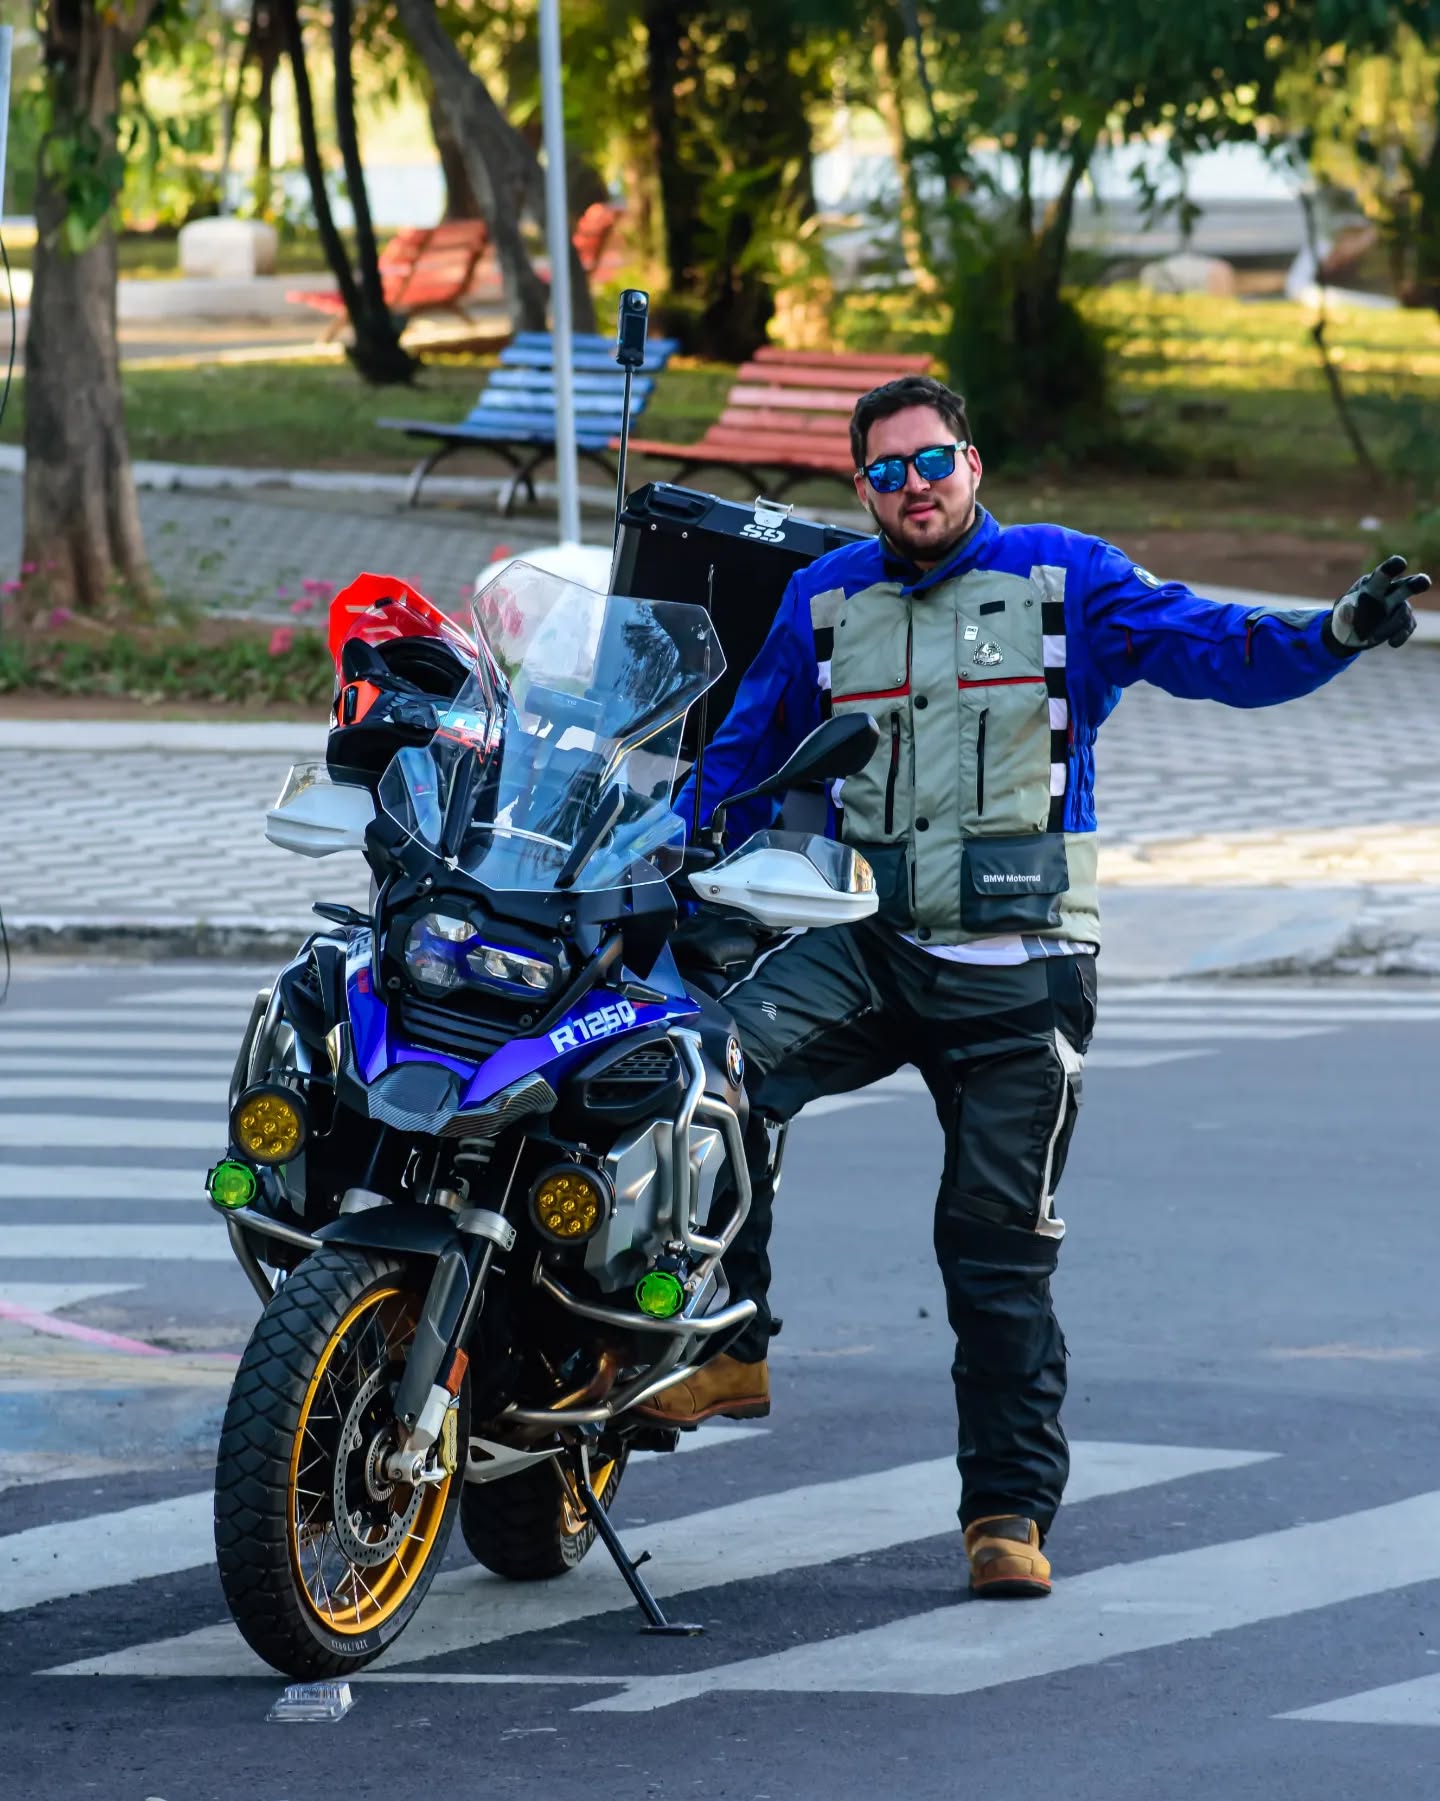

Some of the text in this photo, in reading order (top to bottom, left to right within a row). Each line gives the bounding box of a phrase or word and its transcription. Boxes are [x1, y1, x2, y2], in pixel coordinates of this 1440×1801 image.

[739, 523, 786, 543] GS
[983, 874, 1041, 883] BMW Motorrad
[549, 1000, 637, 1054] R 1250
